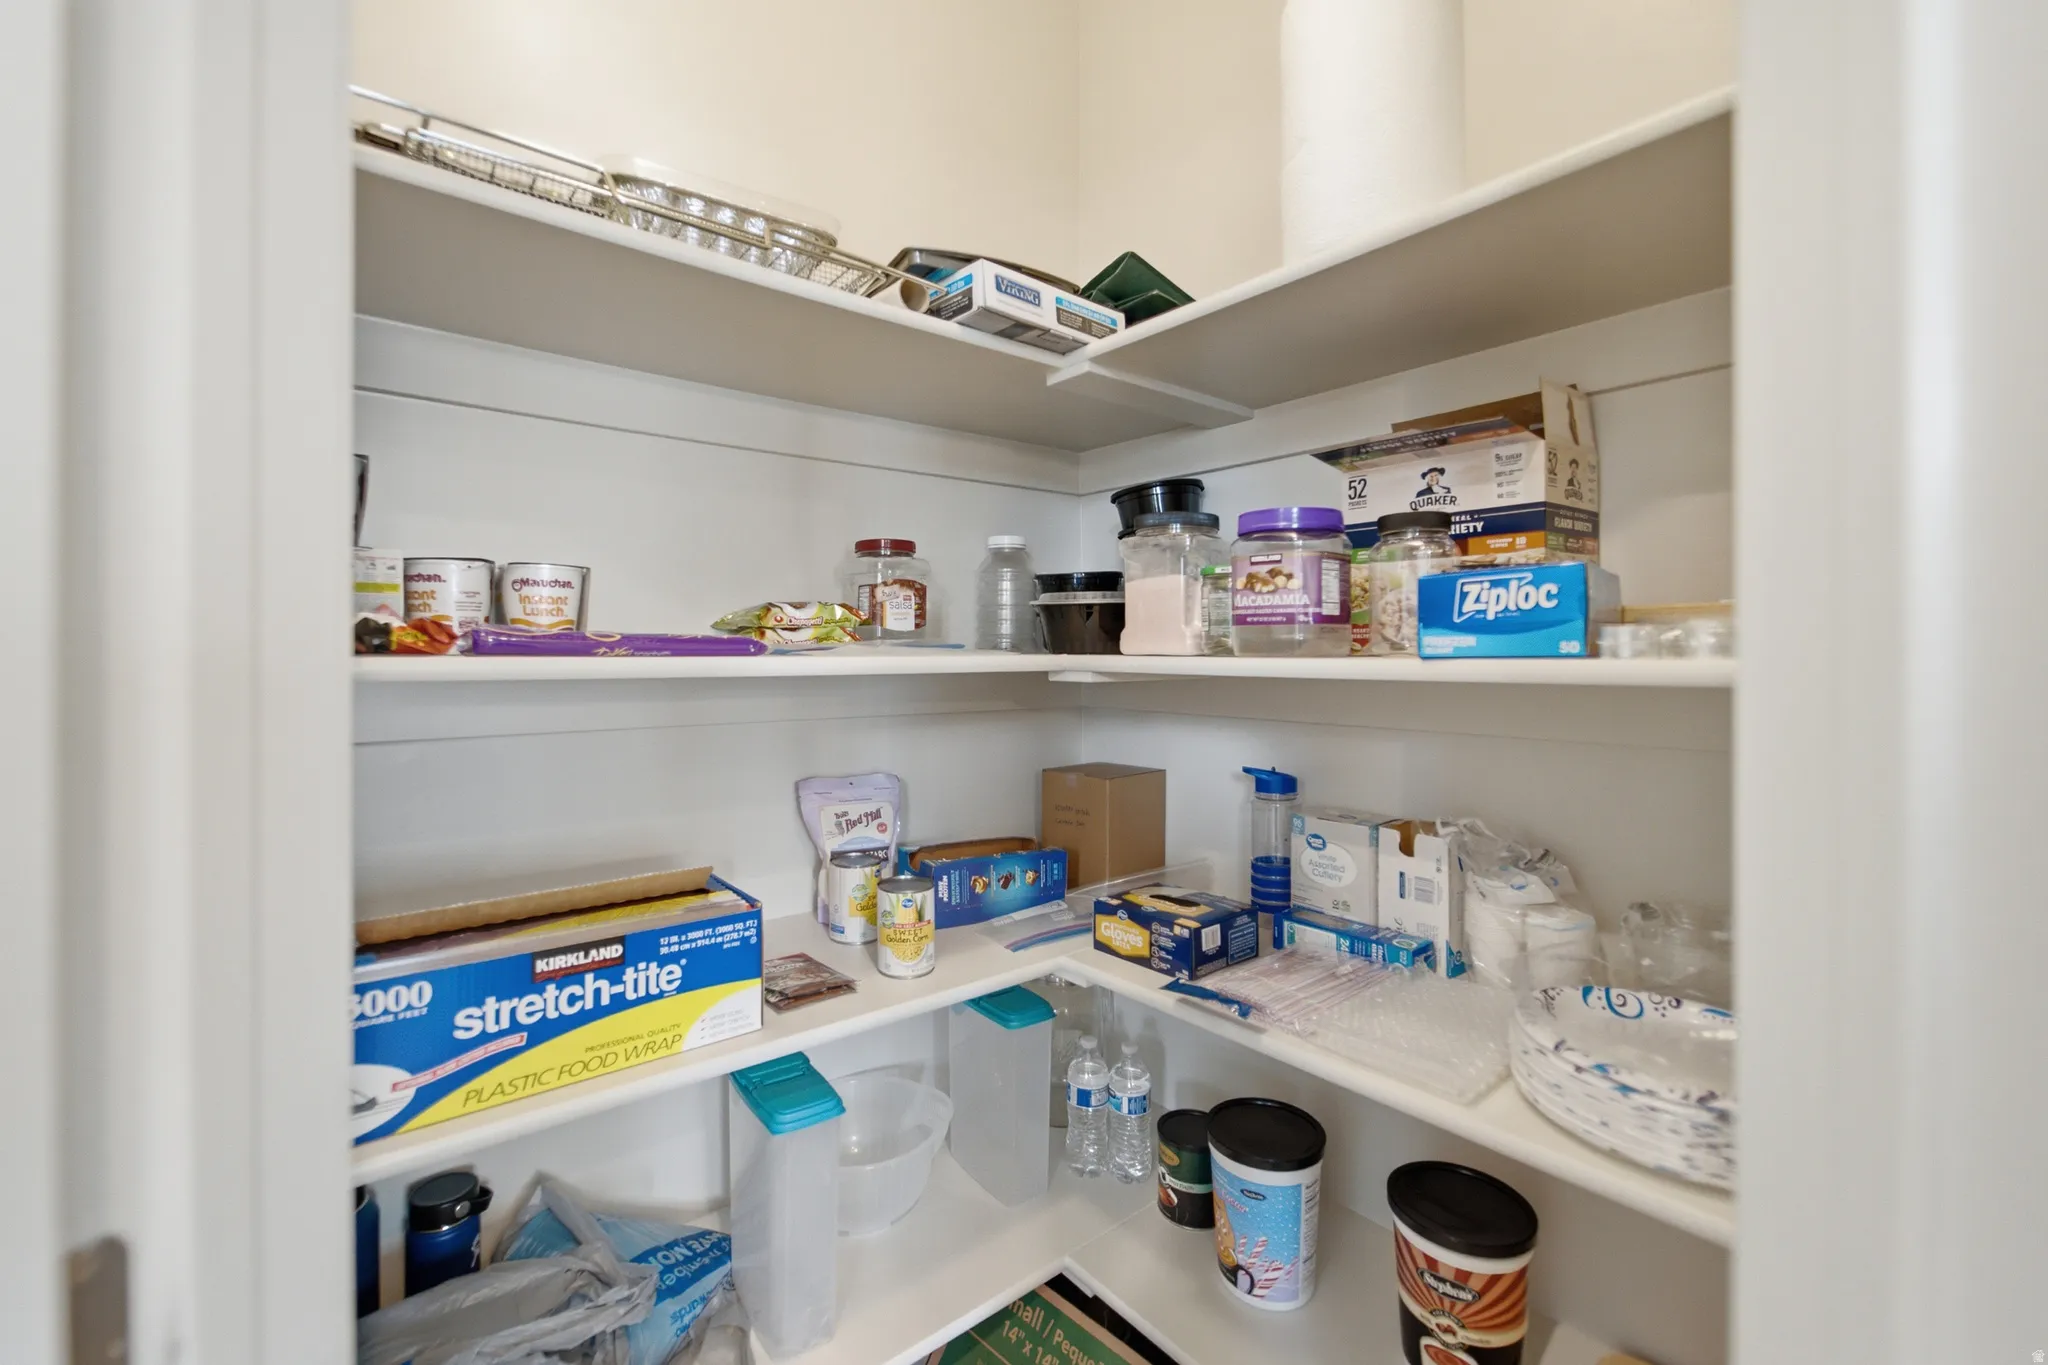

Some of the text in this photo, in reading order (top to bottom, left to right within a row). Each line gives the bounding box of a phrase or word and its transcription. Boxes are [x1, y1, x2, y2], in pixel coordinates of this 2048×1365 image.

[999, 277, 1040, 304] VIKING
[1348, 477, 1368, 501] 52
[1409, 495, 1458, 511] QUAKER
[512, 578, 572, 592] Maruchan
[519, 594, 568, 606] Instant
[523, 604, 565, 618] Lunch
[1234, 593, 1311, 608] MACADAMIA
[1461, 579, 1559, 621] Ziploc
[845, 807, 883, 834] Red Mill
[1308, 859, 1346, 873] Assorted
[1312, 868, 1343, 883] Cutlery
[886, 934, 929, 943] Golden Corn
[893, 928, 923, 936] SWEET
[1101, 921, 1144, 948] Gloves
[536, 944, 624, 974] KIRKLAND
[453, 960, 682, 1040] stretch-tite
[585, 1033, 644, 1054] PROFESSIONAL
[646, 1022, 682, 1038] QUALITY
[463, 1034, 683, 1108] PLASTIC FOOD WRAP
[1002, 1320, 1026, 1345] 14"
[1008, 1299, 1045, 1332] mall
[1053, 1328, 1105, 1365] Pequ
